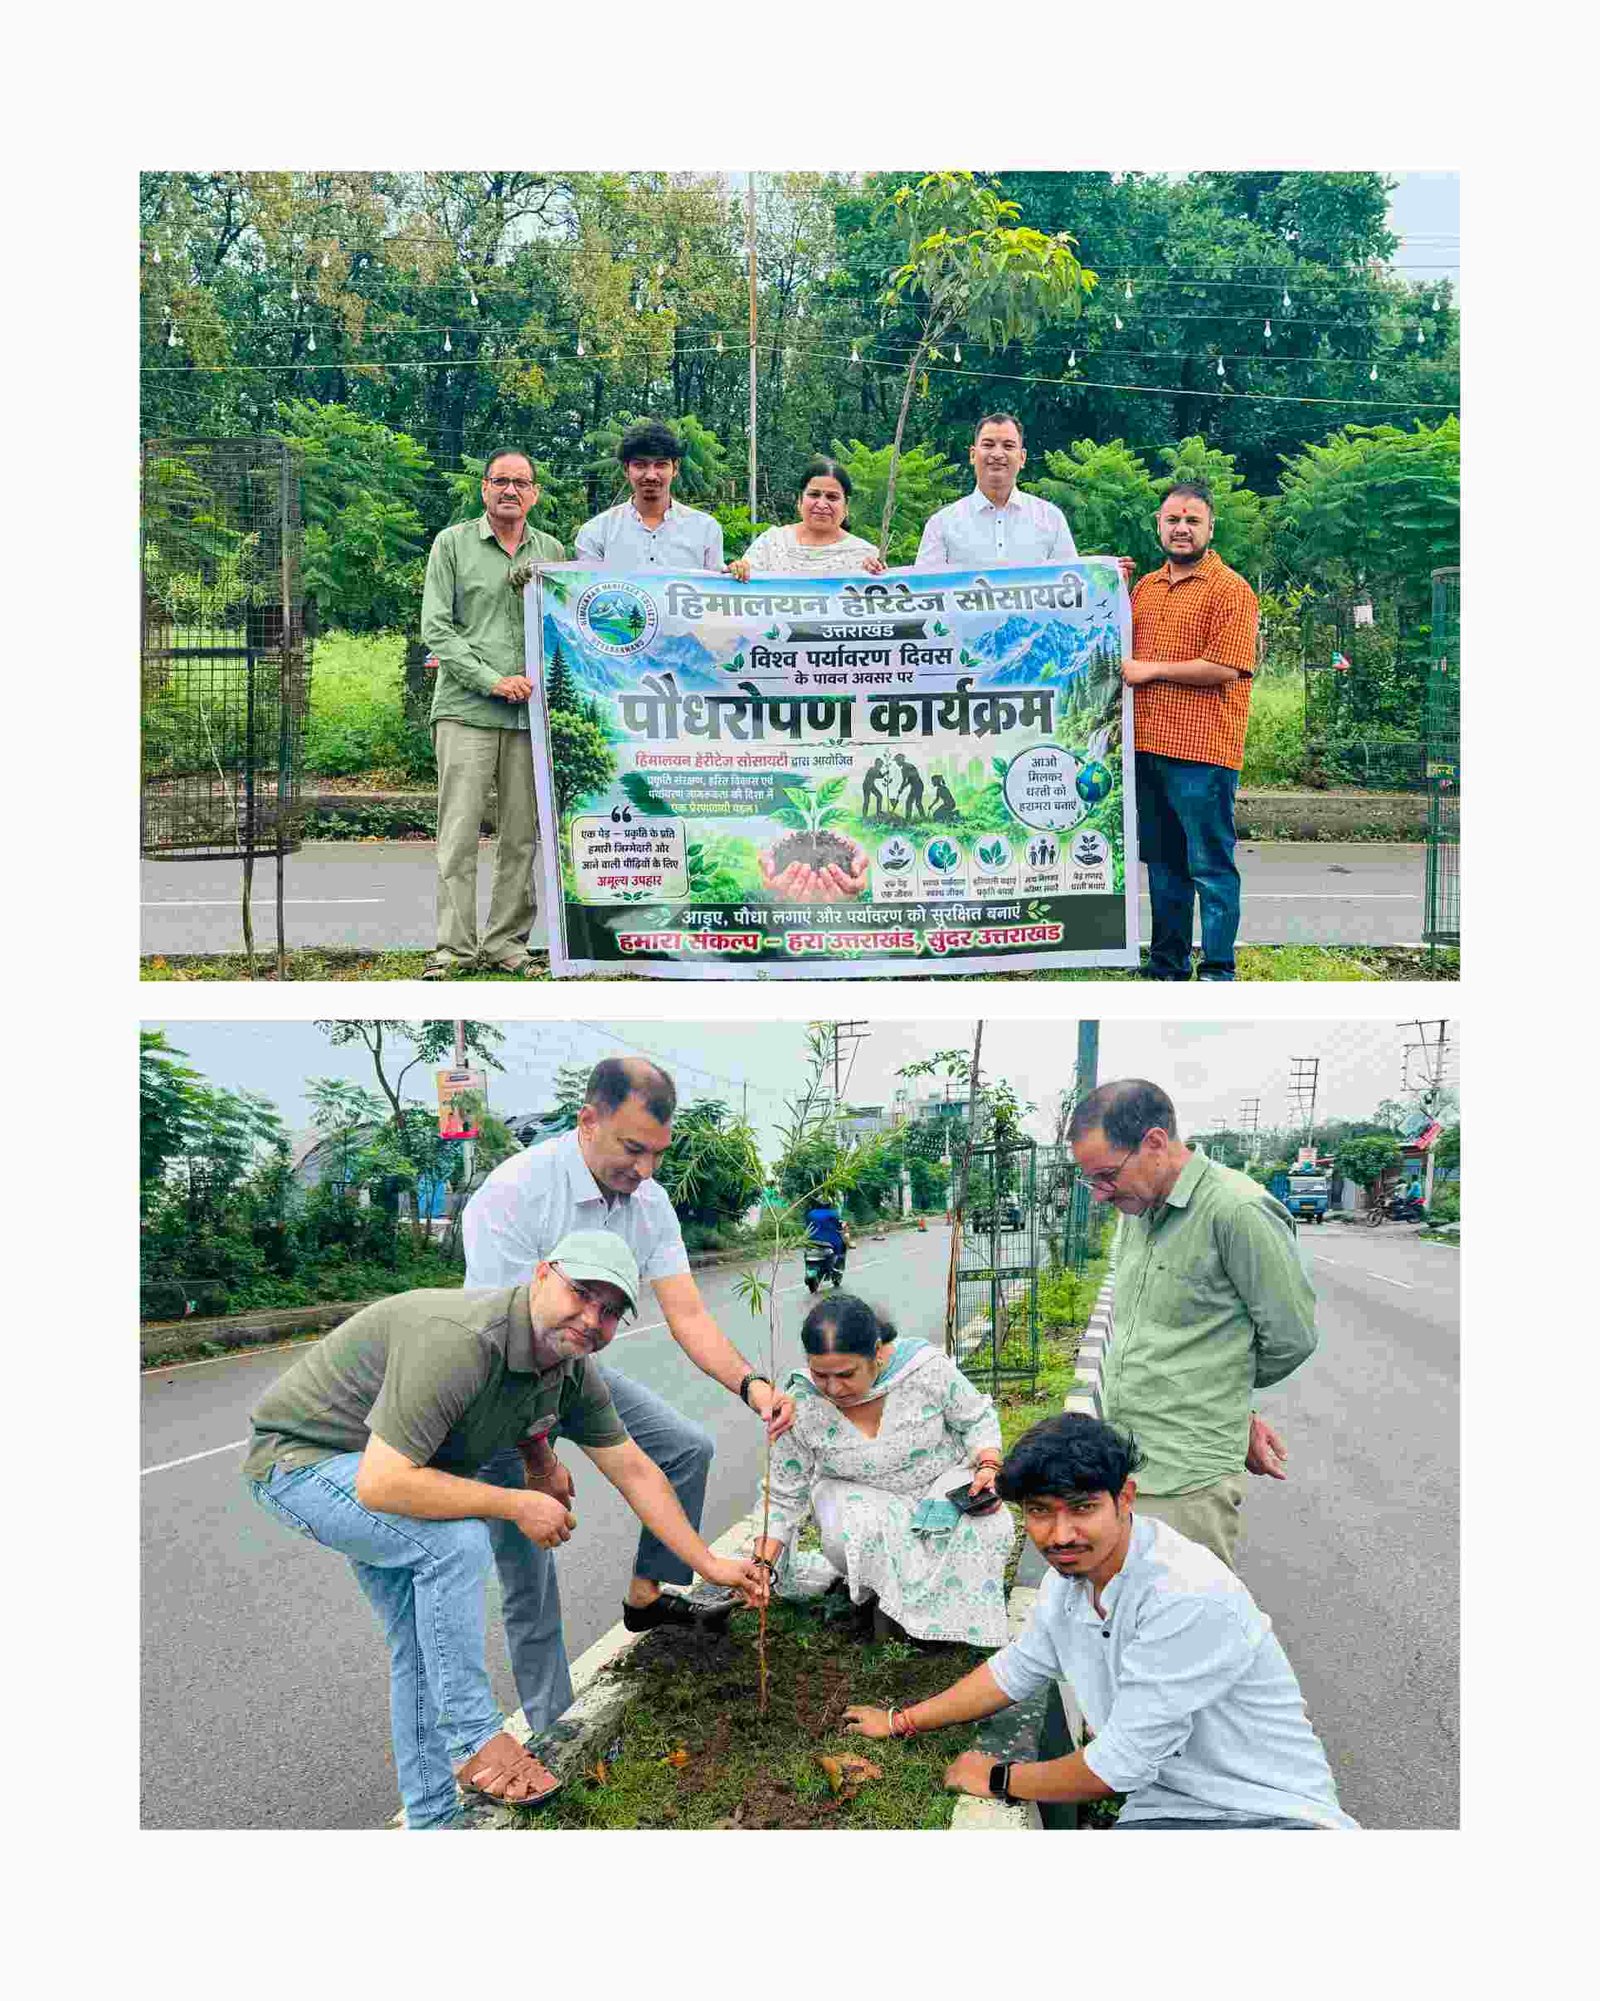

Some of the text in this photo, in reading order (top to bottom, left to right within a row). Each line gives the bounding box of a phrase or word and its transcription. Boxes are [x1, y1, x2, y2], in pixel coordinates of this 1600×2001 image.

[665, 573, 1084, 619] हिमालयन हेरिटेज सोसायटी
[822, 620, 894, 639] उत्तराखंड
[750, 643, 953, 668] विश्व पर्यावरण दिवस
[794, 670, 913, 684] के पावन अवसर पर
[618, 672, 1054, 740] पौधरोपण कार्यक्रम
[636, 751, 691, 767] हिमालयन
[736, 751, 789, 767] सोसायटी
[597, 875, 663, 889] अमूल्य उपहार
[681, 902, 1021, 927] आइए, पौधा लगाएं और पर्यावरण को सुरक्षित बनाएं
[618, 932, 680, 951] हमारा
[688, 928, 760, 952] संकल्प
[787, 932, 824, 951] हरा
[828, 926, 922, 953] उत्तराखंड,
[926, 923, 974, 953] सुंदर
[978, 919, 1062, 943] उत्तराखंड
